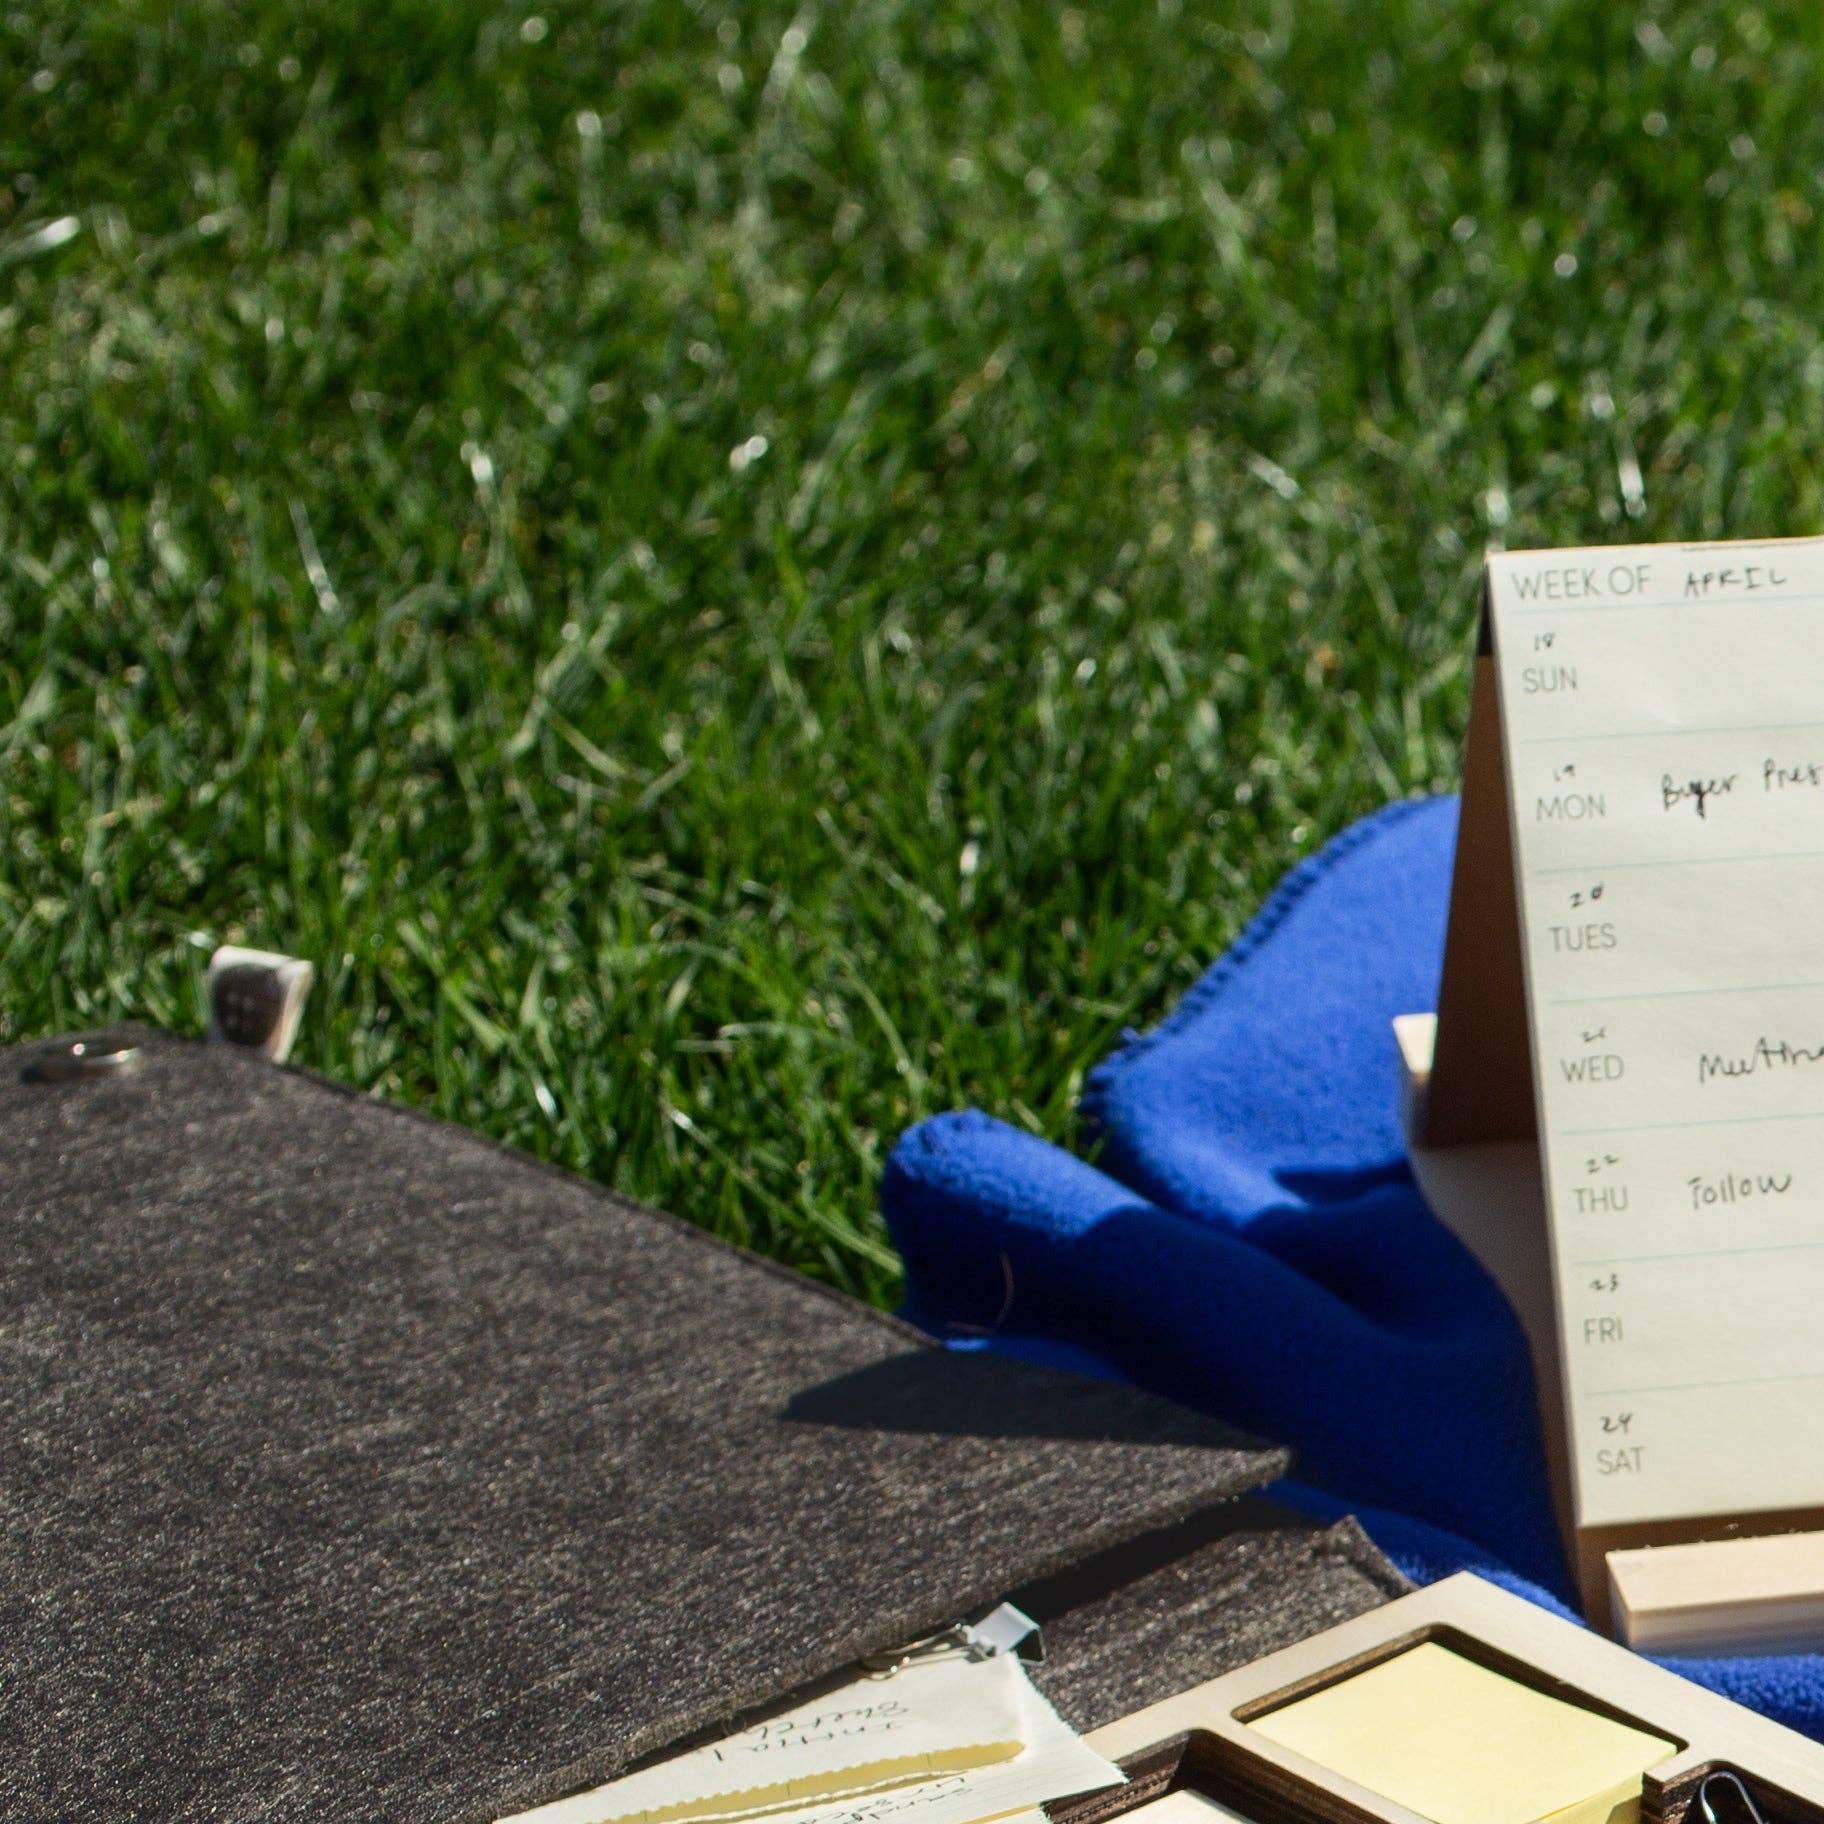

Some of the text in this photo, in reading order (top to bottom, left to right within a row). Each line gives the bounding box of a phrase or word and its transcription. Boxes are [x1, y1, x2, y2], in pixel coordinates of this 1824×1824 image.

[1512, 564, 1652, 601] WEEK OF
[1683, 566, 1787, 599] APRIL
[1533, 631, 1556, 653] 18
[1521, 667, 1579, 695] SUN
[1535, 794, 1607, 823] MON
[1569, 881, 1604, 908] 20
[1548, 923, 1618, 953] TUES
[1558, 1053, 1626, 1083] WED
[1571, 1186, 1630, 1214] THU
[1583, 1316, 1625, 1345] FRI
[1599, 1411, 1634, 1435] 24
[1596, 1446, 1648, 1476] SAT
